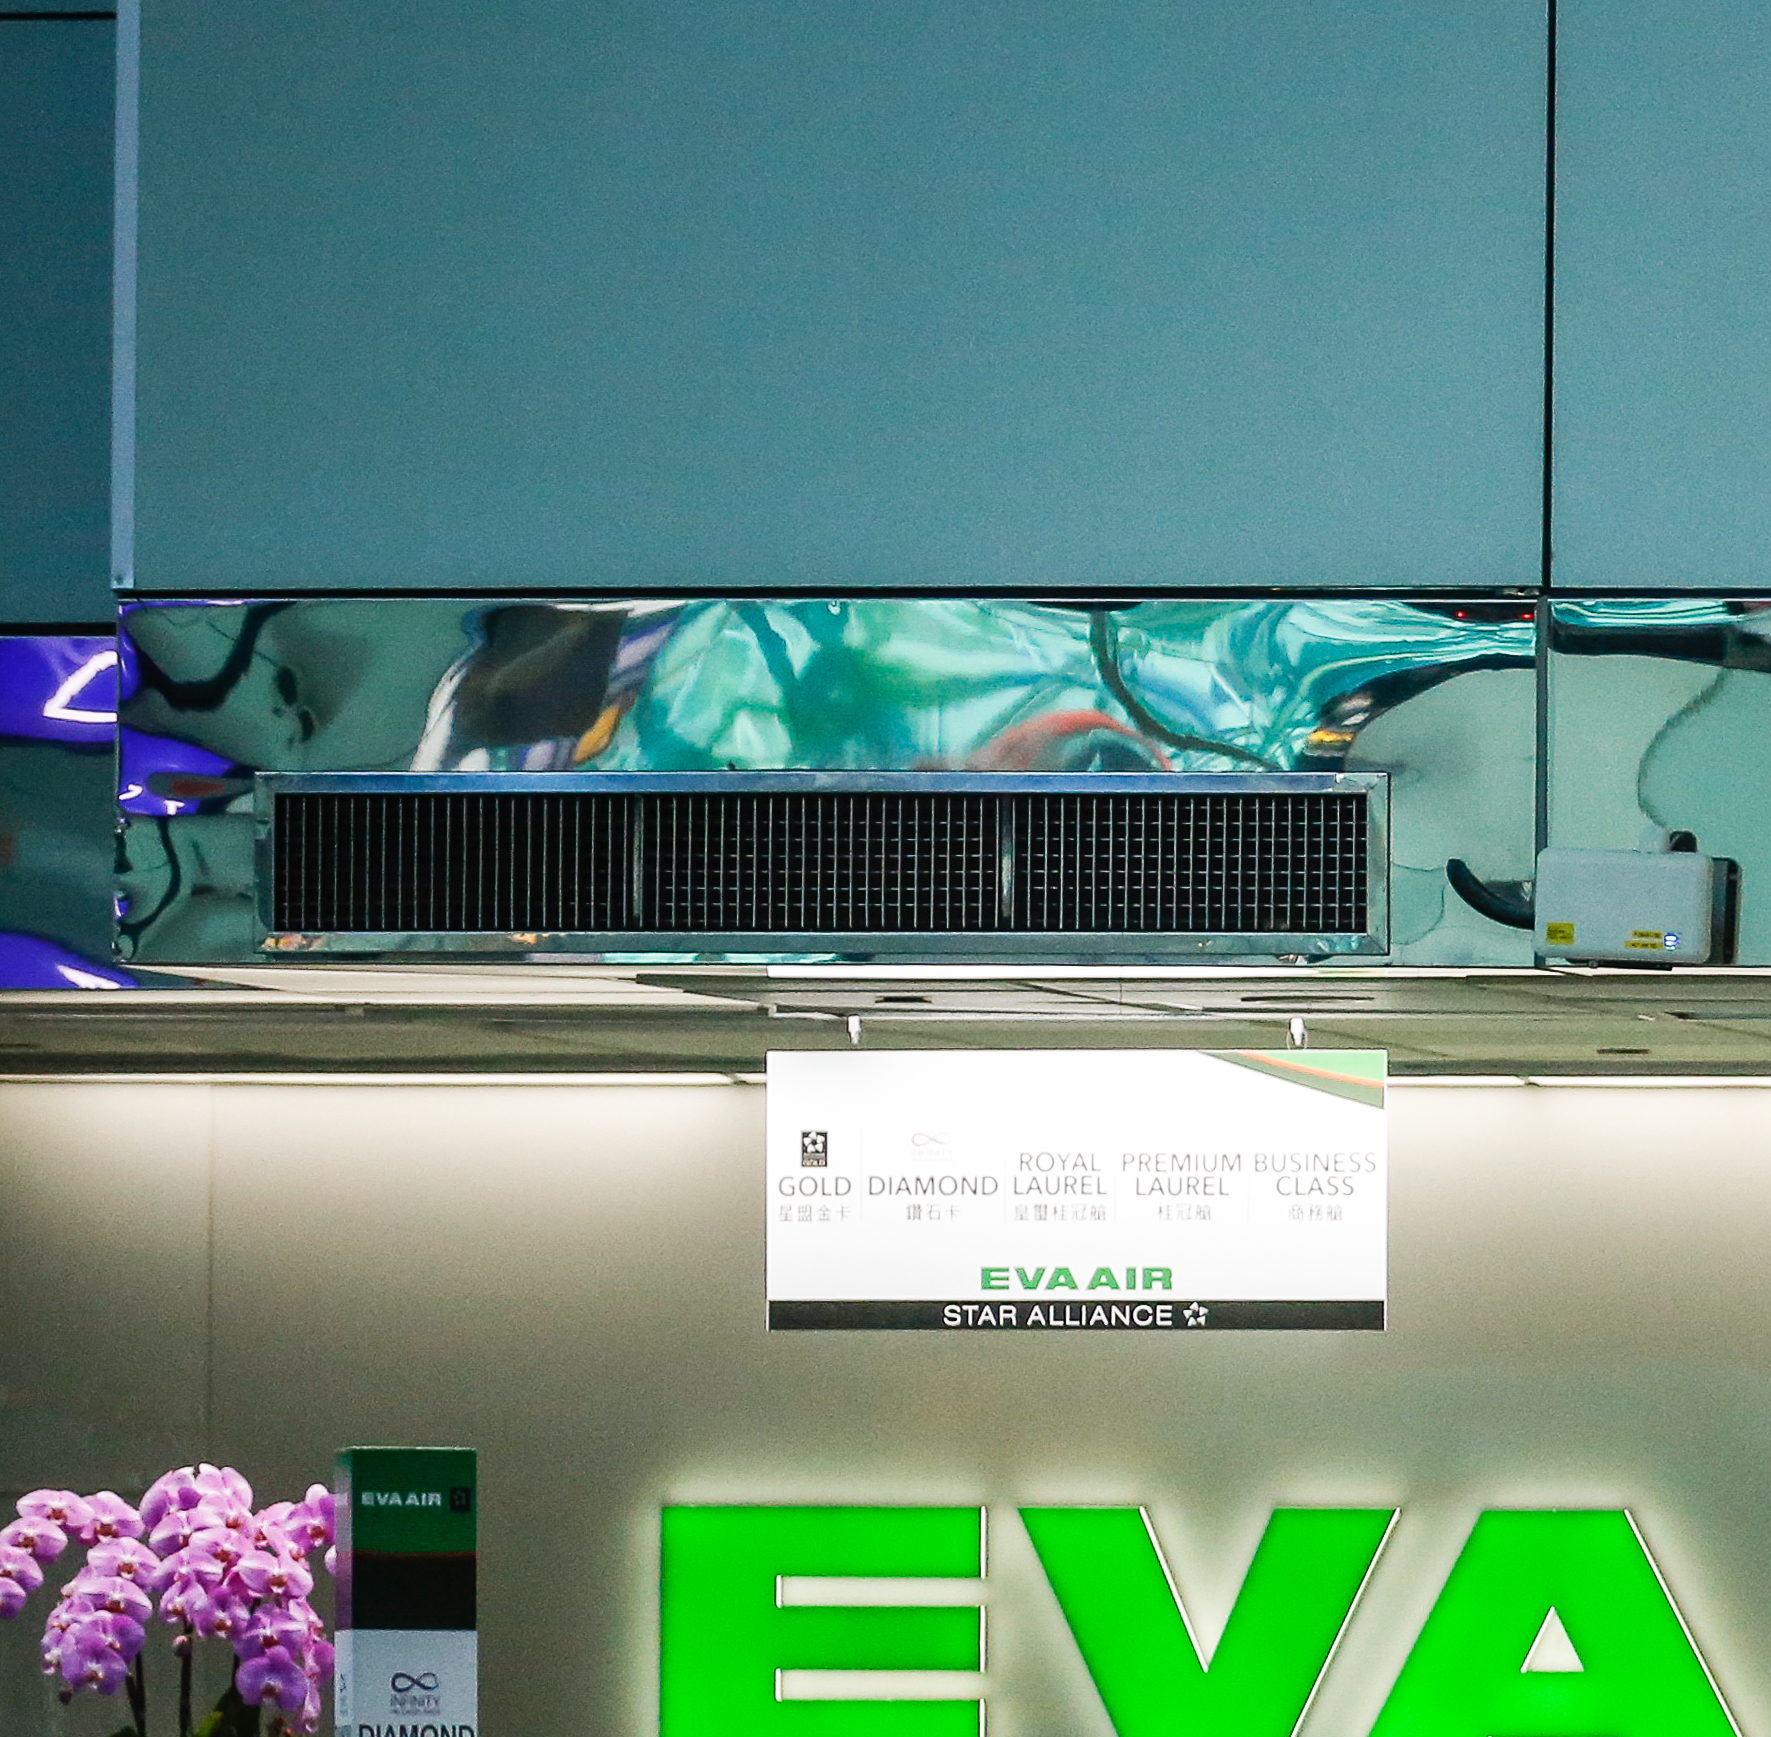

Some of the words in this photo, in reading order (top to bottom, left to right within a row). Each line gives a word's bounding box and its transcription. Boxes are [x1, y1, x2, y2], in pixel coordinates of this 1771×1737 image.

[1020, 1152, 1101, 1172] ROYAL
[1123, 1153, 1241, 1172] PREMIUM
[1255, 1153, 1376, 1172] BUSINESS
[779, 1176, 851, 1196] GOLD
[869, 1176, 998, 1196] DIAMOND
[1014, 1176, 1107, 1195] LAUREL
[1136, 1176, 1229, 1196] LAUREL
[1276, 1176, 1354, 1196] CLASS
[942, 1304, 1018, 1327] STAR
[1026, 1304, 1174, 1327] ALLIANCE
